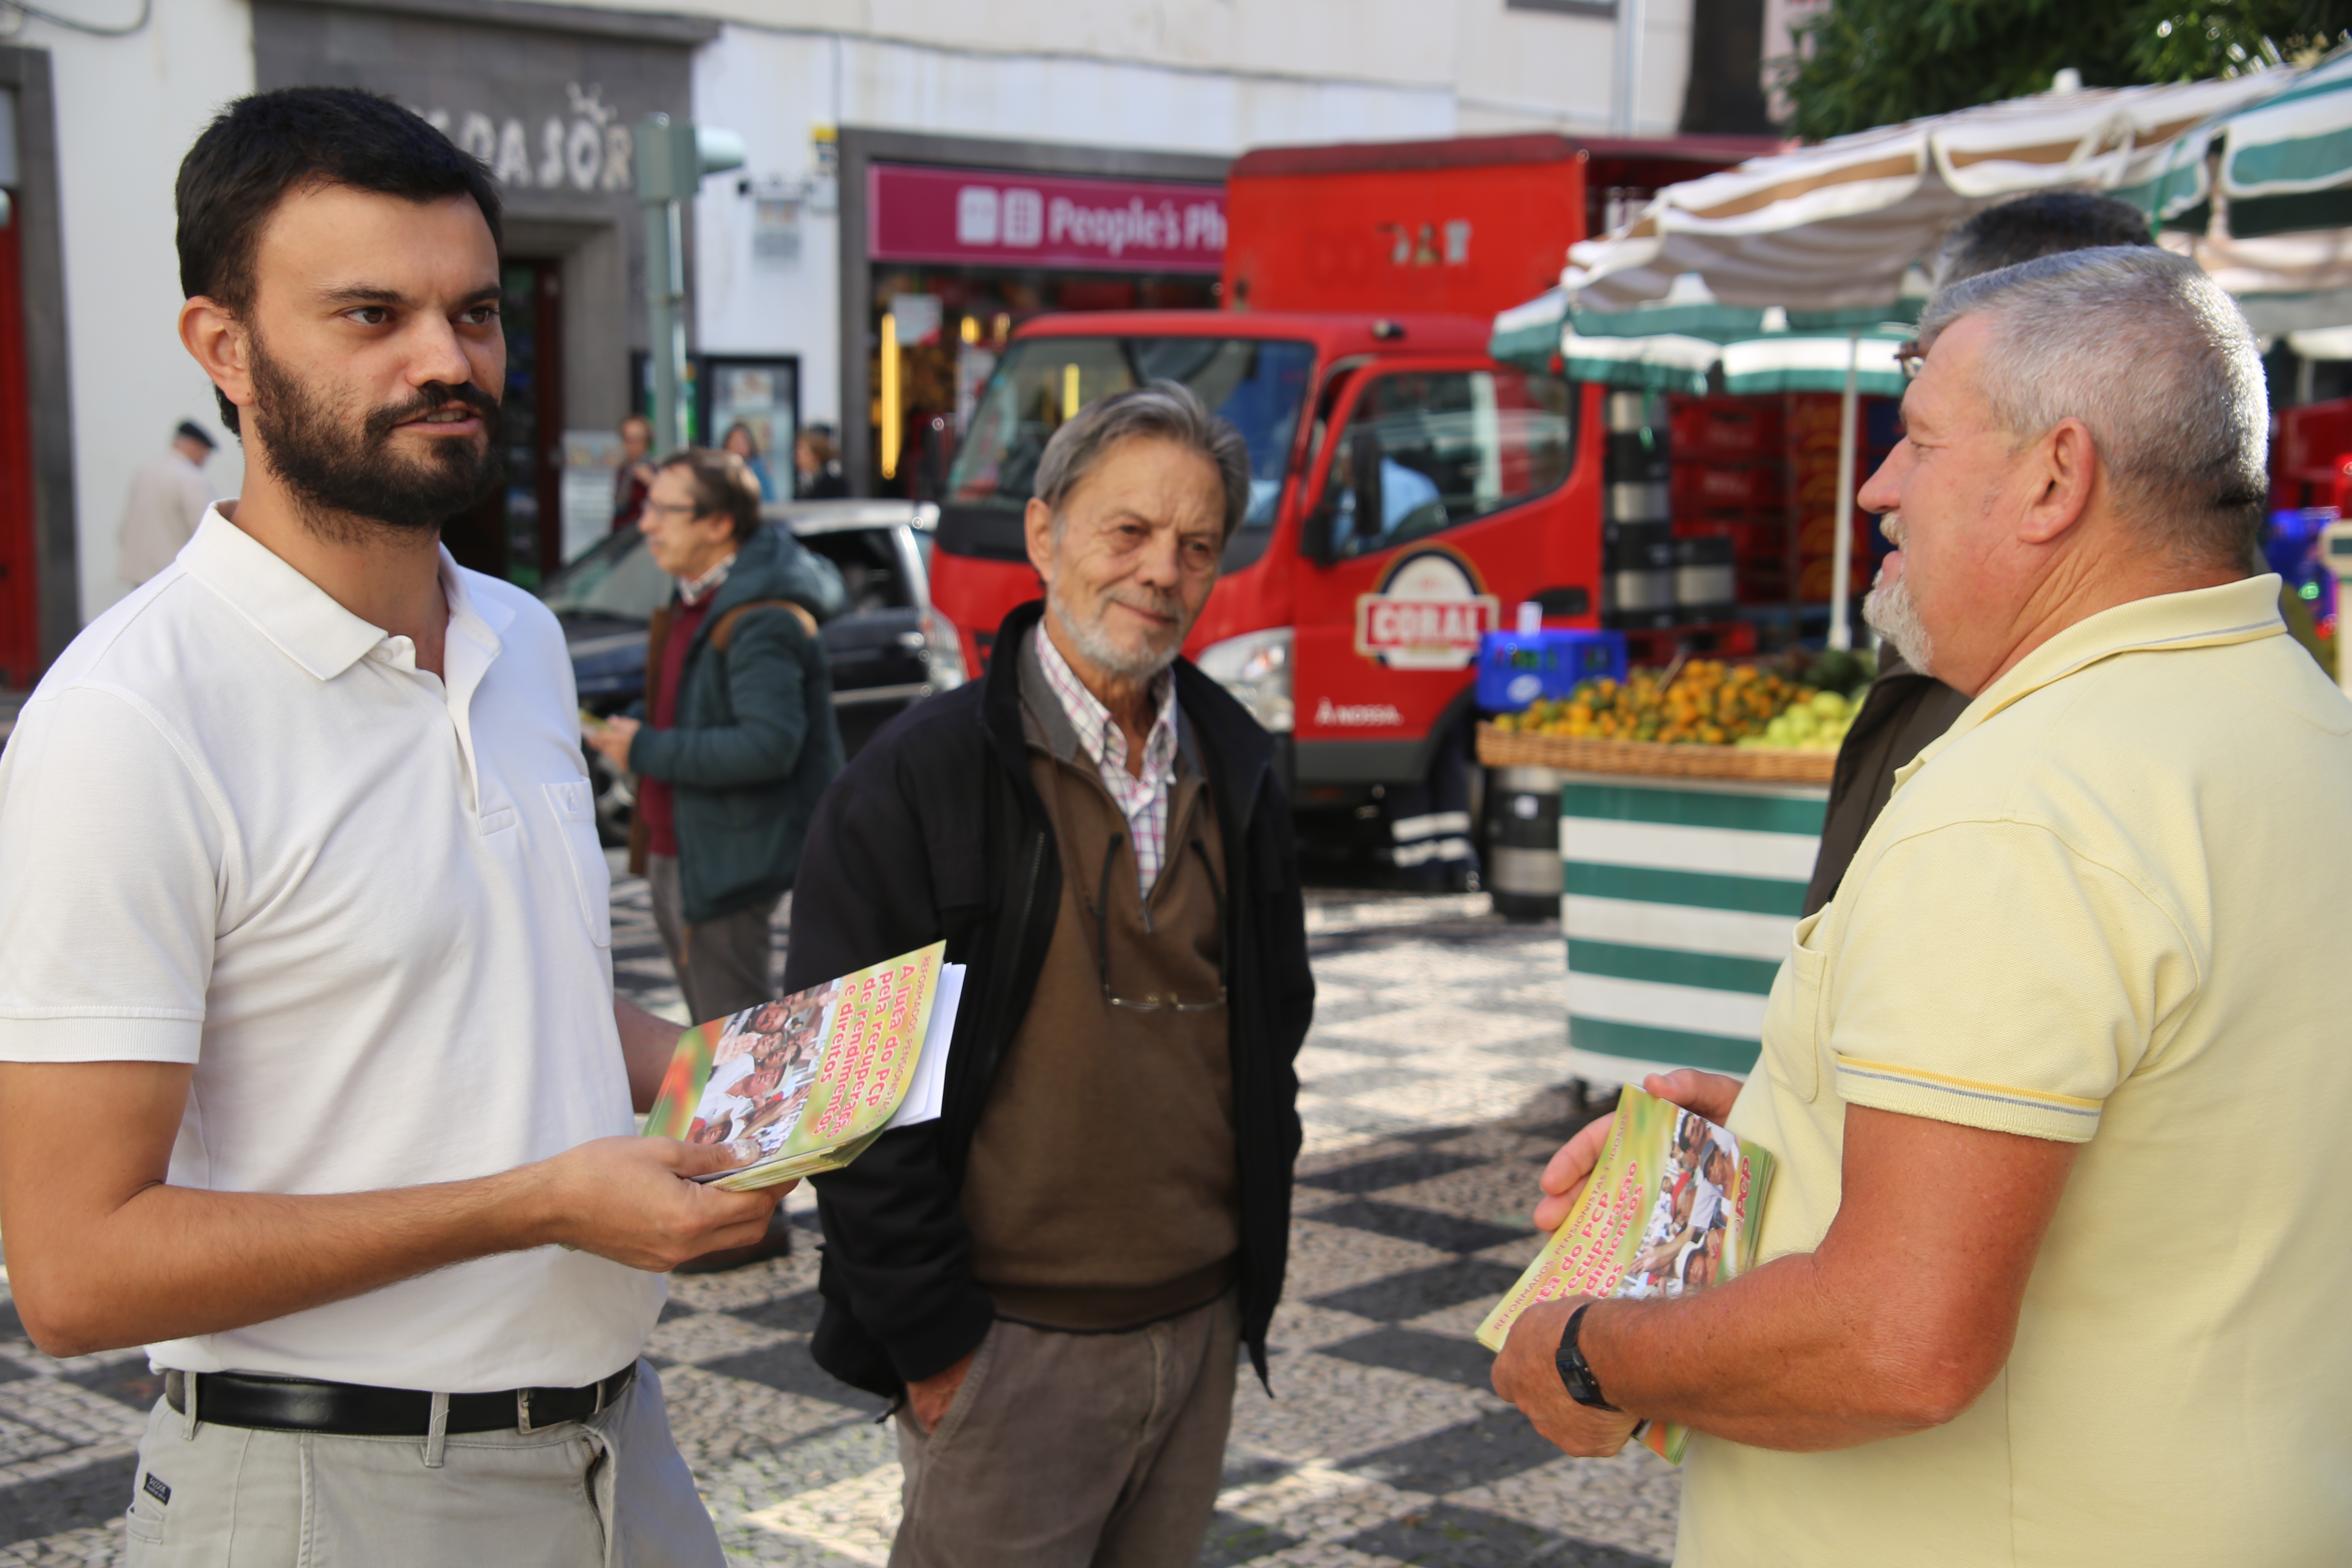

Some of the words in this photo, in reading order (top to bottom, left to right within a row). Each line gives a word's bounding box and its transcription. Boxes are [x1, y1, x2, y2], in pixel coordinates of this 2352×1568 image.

[1048, 195, 1182, 258] People's
[1372, 606, 1479, 642] CORAL
[844, 983, 858, 998] e
[860, 977, 878, 1004] de
[874, 969, 895, 1017] pela
[899, 964, 916, 983] A
[888, 984, 912, 1031] luta
[820, 1001, 854, 1083] direitos
[880, 1035, 900, 1063] do
[812, 1008, 869, 1135] rendimentos
[825, 1020, 884, 1139] recuperação
[865, 1066, 892, 1107] PCP
[1735, 1155, 1752, 1219] PCP
[1493, 1257, 1557, 1331] REFORMADOS,
[1554, 1173, 1607, 1256] PENSIONISTAS
[1604, 1163, 1611, 1172] E
[1608, 1112, 1629, 1162] IDOSOS
[1560, 1243, 1583, 1272] do
[1580, 1191, 1610, 1239] PCP
